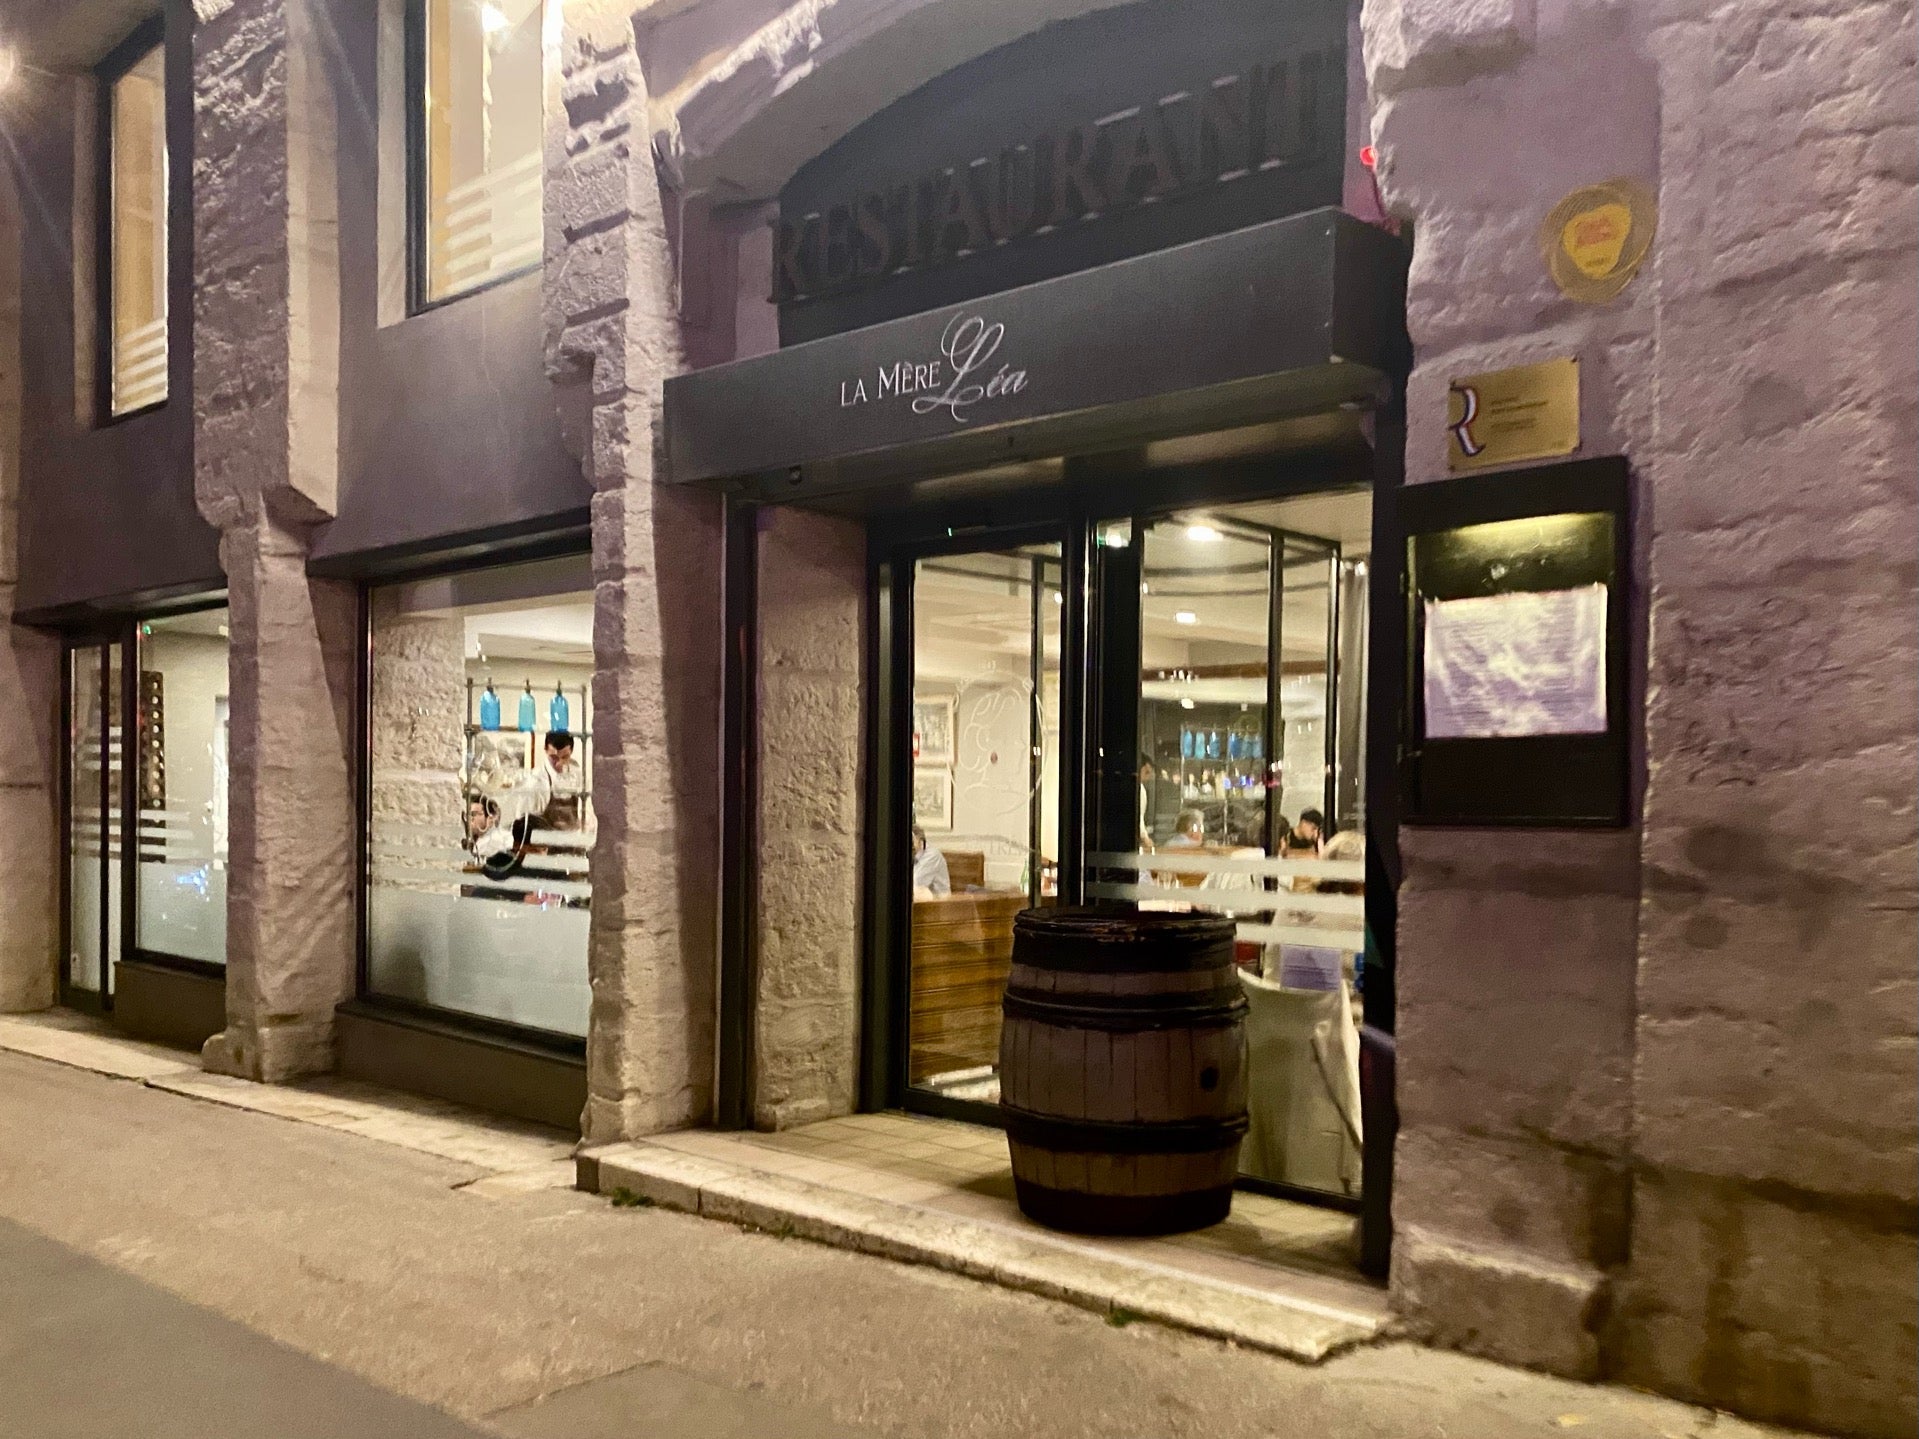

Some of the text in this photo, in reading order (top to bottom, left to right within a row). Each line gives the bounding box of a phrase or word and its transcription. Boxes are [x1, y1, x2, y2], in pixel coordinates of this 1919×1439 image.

[769, 50, 1342, 301] RESTAURANT
[840, 311, 1028, 423] LA MÈRE Léa
